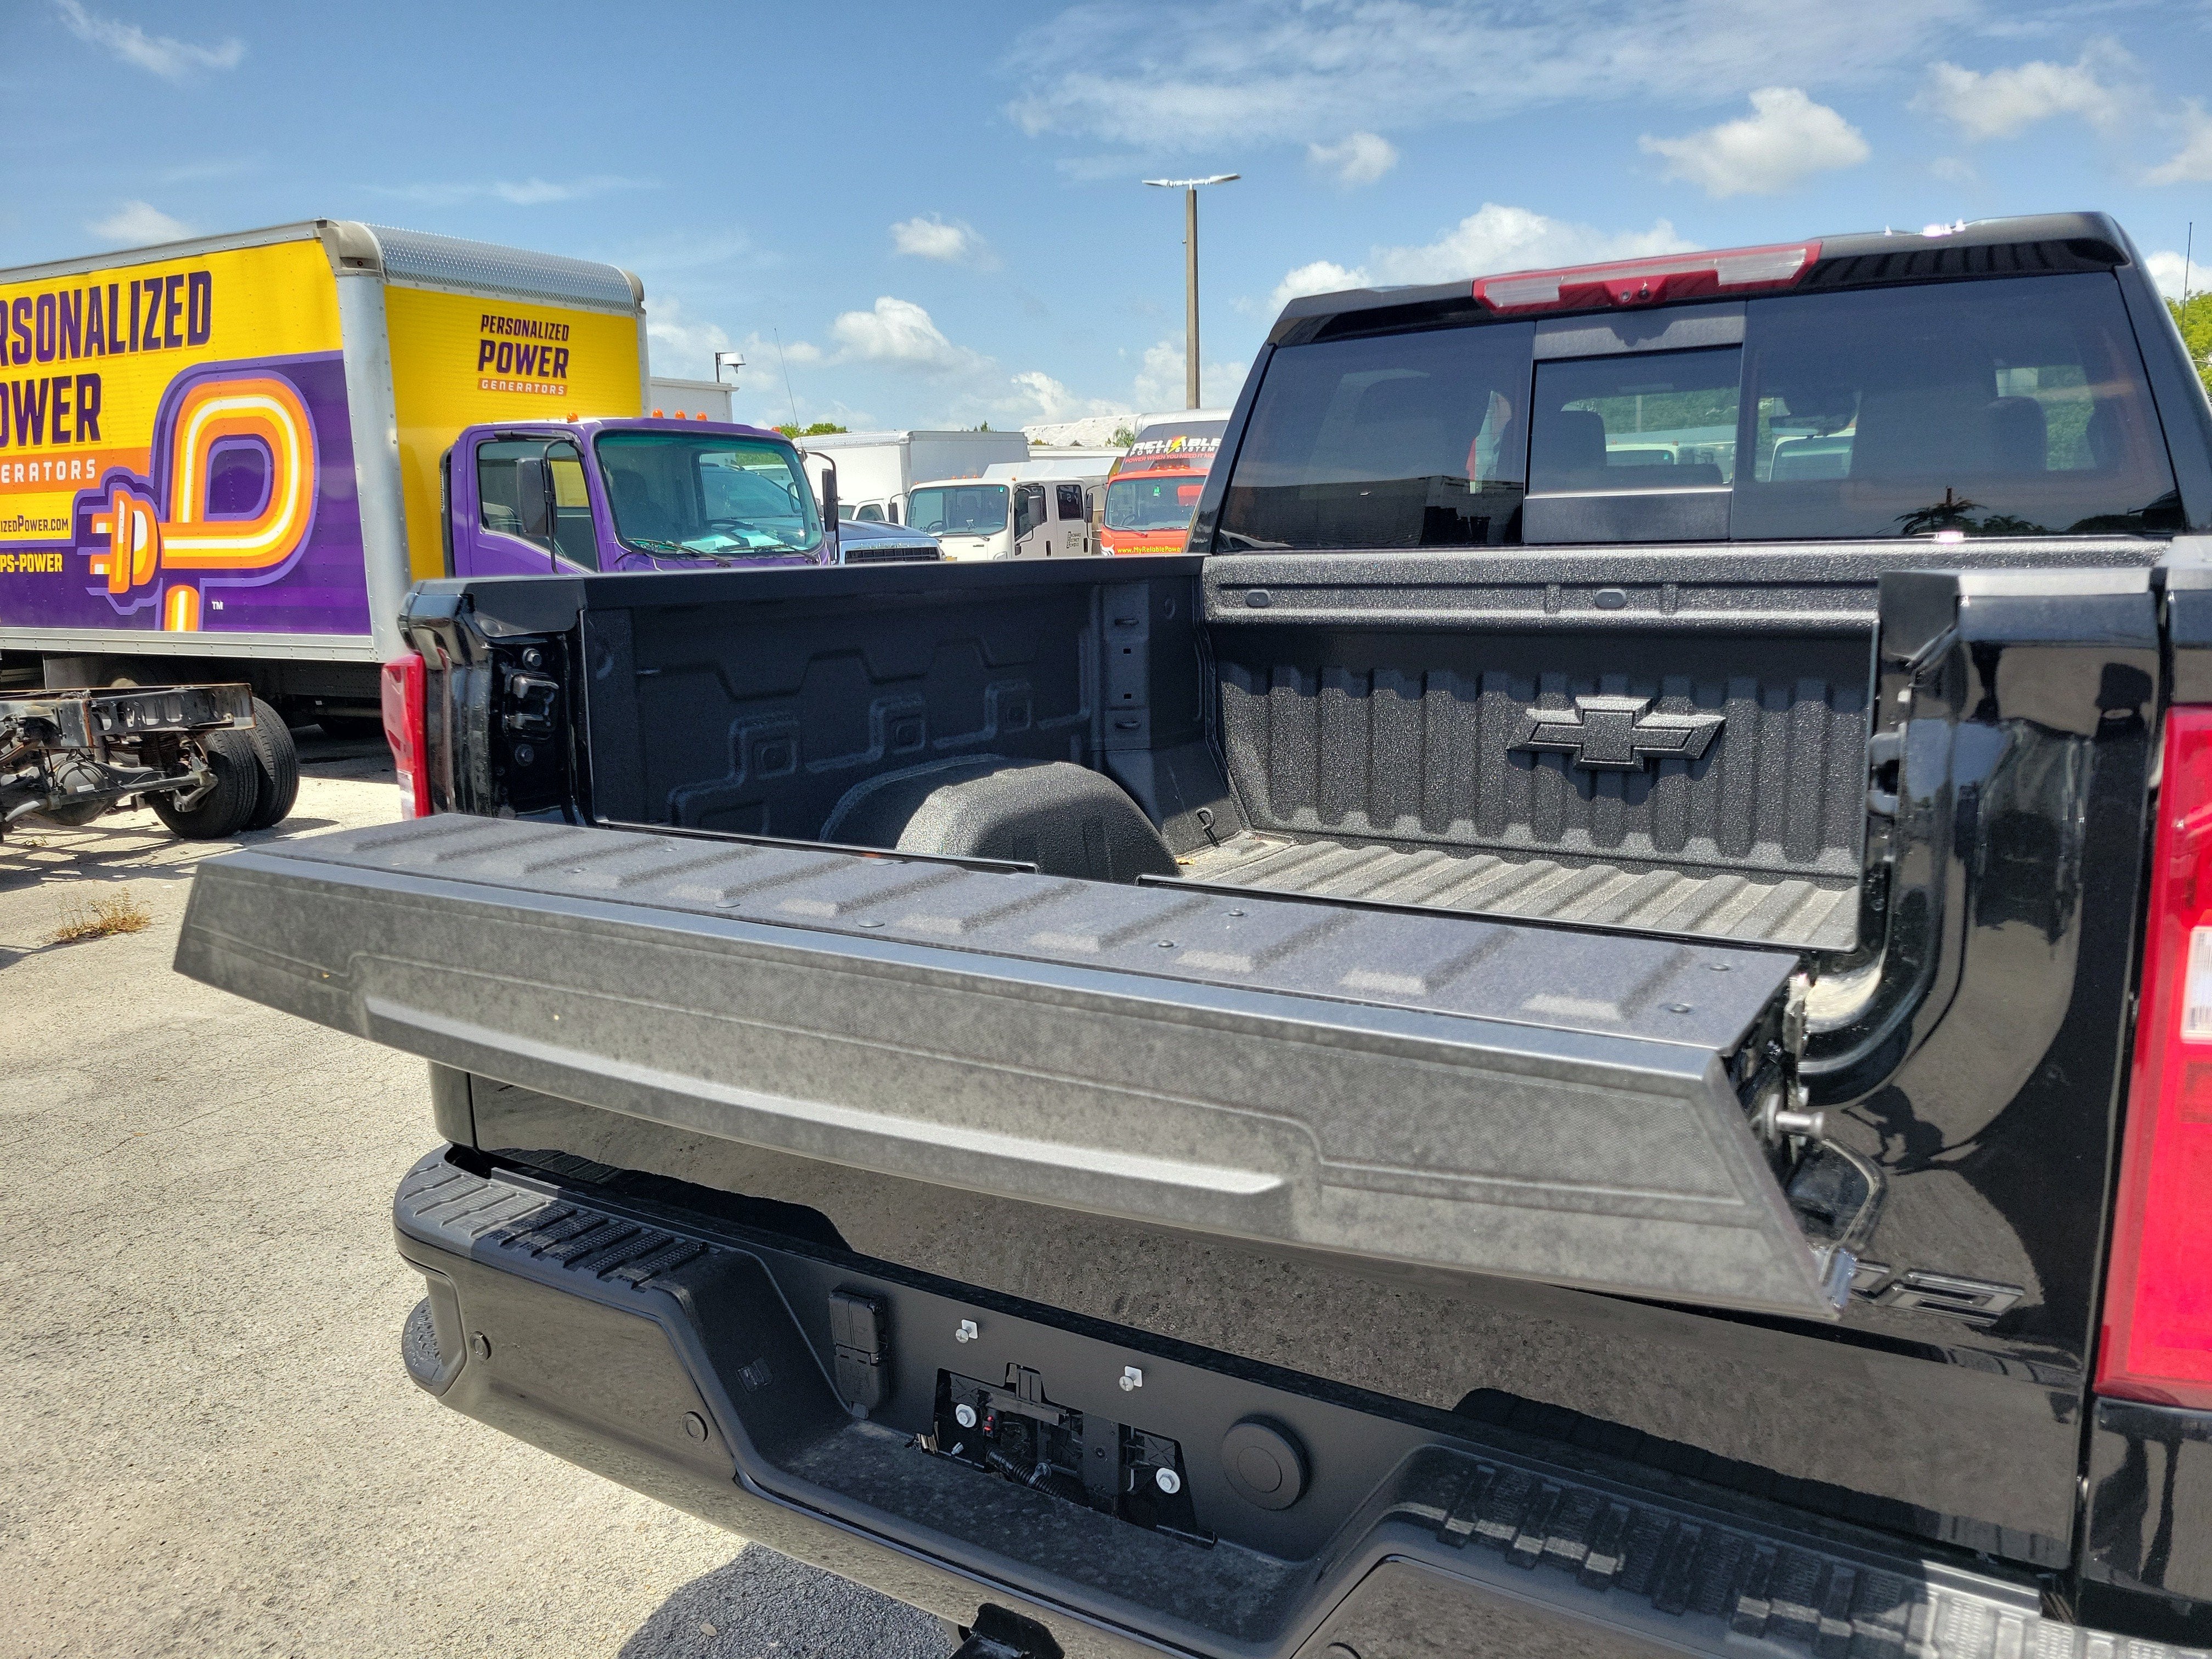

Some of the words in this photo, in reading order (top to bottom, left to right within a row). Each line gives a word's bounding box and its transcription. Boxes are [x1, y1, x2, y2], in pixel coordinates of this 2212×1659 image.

[481, 314, 569, 341] PERSONALIZED
[478, 339, 569, 379] POWER
[482, 379, 564, 395] GENERATORS
[1130, 448, 1168, 457] POWER
[1, 459, 95, 483] ERATORS
